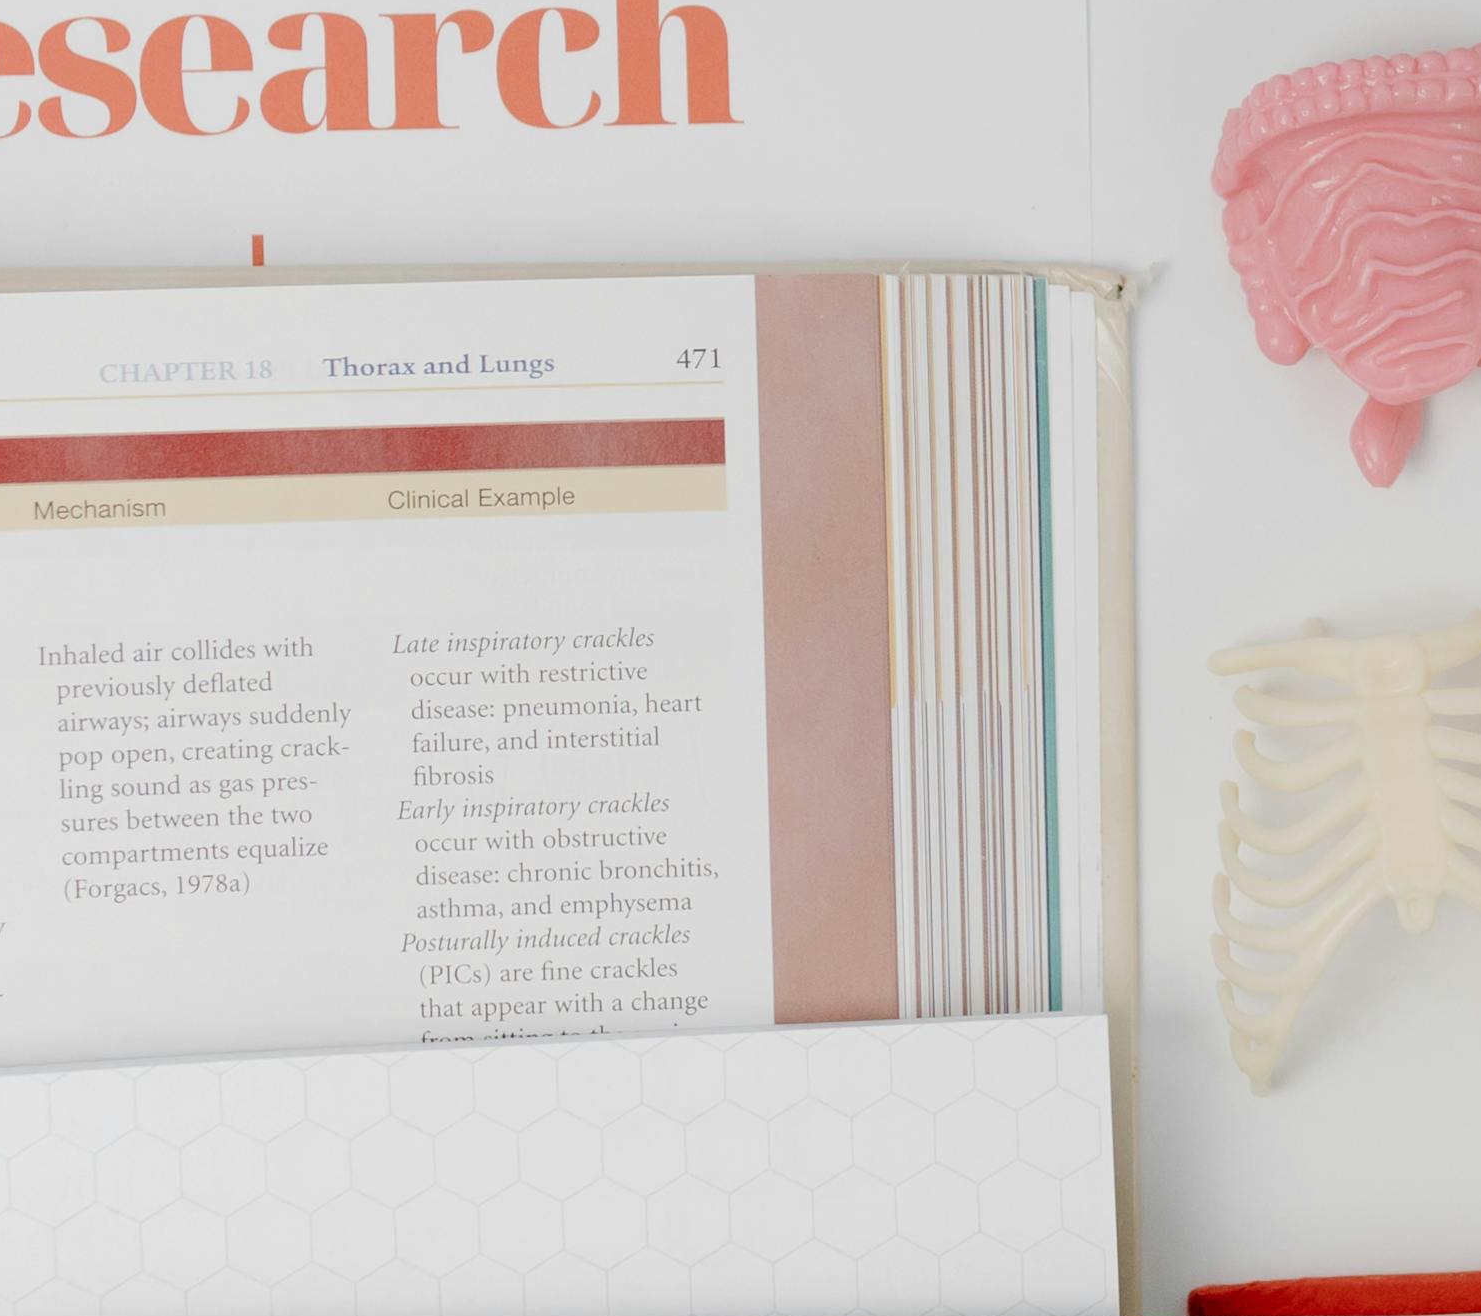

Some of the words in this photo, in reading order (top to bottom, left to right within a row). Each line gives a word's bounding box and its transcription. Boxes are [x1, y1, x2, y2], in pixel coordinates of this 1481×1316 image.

[98, 360, 239, 384] CHAPTER
[245, 359, 274, 380] 18
[321, 355, 416, 378] Thorax
[422, 352, 472, 376] and
[478, 354, 556, 380] Lungs
[675, 347, 722, 370] 471
[33, 498, 167, 521] Mechanism
[387, 488, 469, 511] Clinical
[478, 485, 576, 512] Example
[38, 642, 125, 667] Inhaled
[132, 641, 164, 663] air
[170, 637, 256, 662] collides
[262, 635, 314, 658] with
[391, 634, 440, 655] Late
[446, 630, 567, 659] inspiratory
[572, 626, 656, 649] crackles
[63, 877, 168, 905] (Forgacs,
[176, 871, 251, 896] 1978a)
